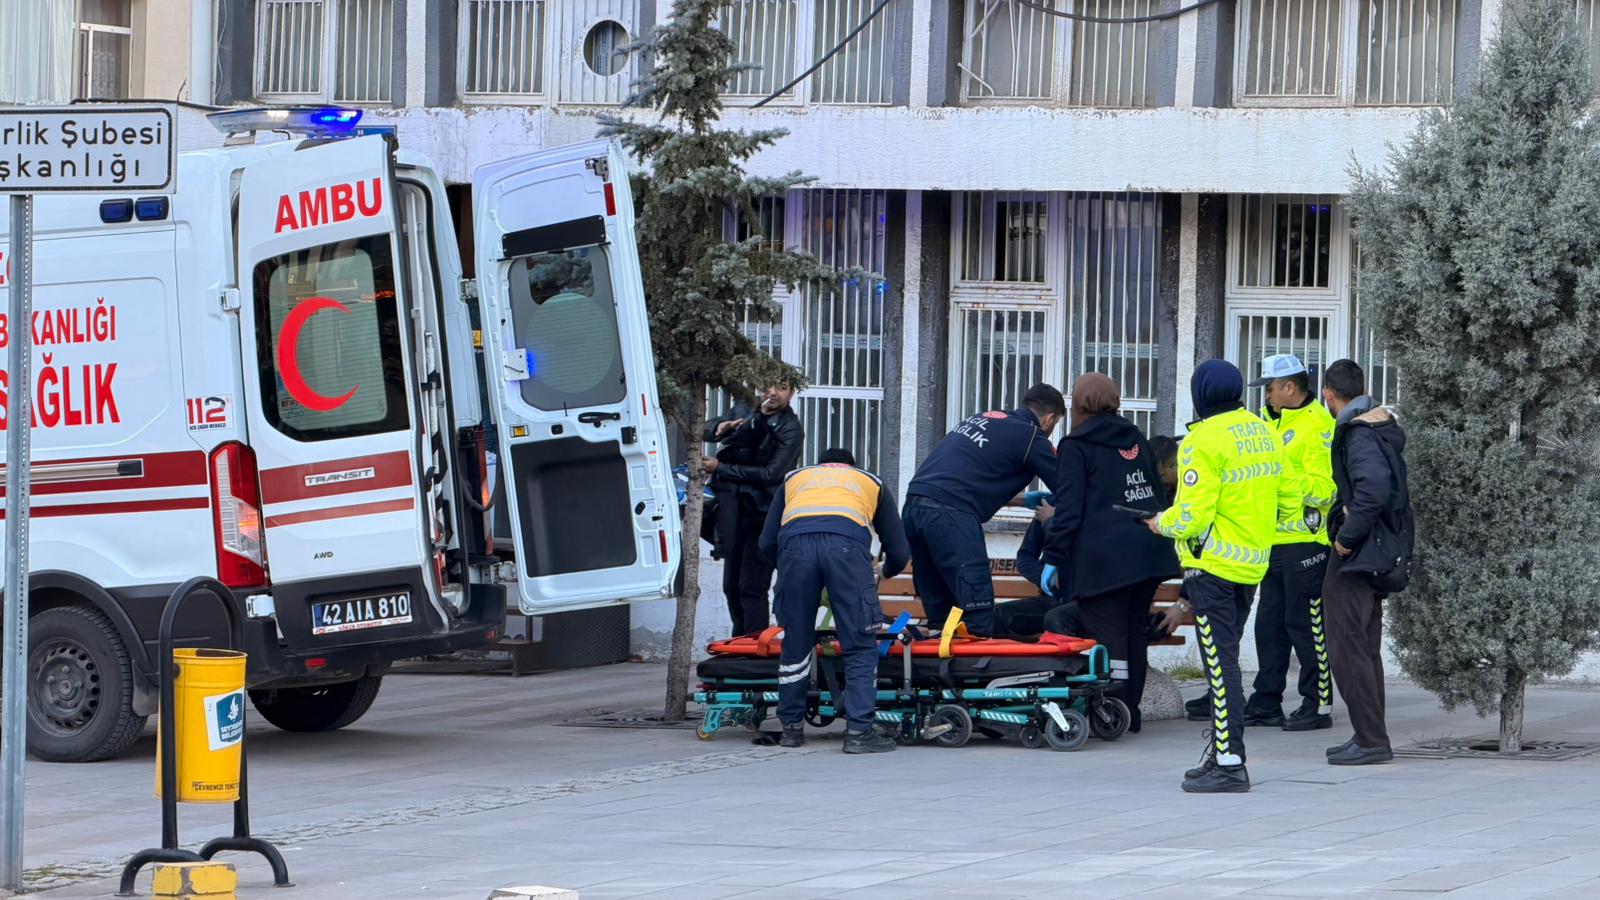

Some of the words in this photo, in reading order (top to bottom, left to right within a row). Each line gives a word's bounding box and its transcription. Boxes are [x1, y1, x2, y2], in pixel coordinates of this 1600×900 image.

[3, 120, 49, 145] rlik
[61, 120, 162, 149] Şubesi
[274, 177, 383, 234] AMBU
[0, 297, 116, 348] BKANLIĞI
[0, 352, 121, 431] SĞLIK
[187, 397, 226, 425] 112
[306, 468, 373, 485] TRANSIT
[1126, 468, 1146, 485] ACİL
[313, 551, 334, 560] AWD
[322, 602, 342, 625] 42
[345, 598, 375, 623] AIA
[378, 595, 408, 618] 810
